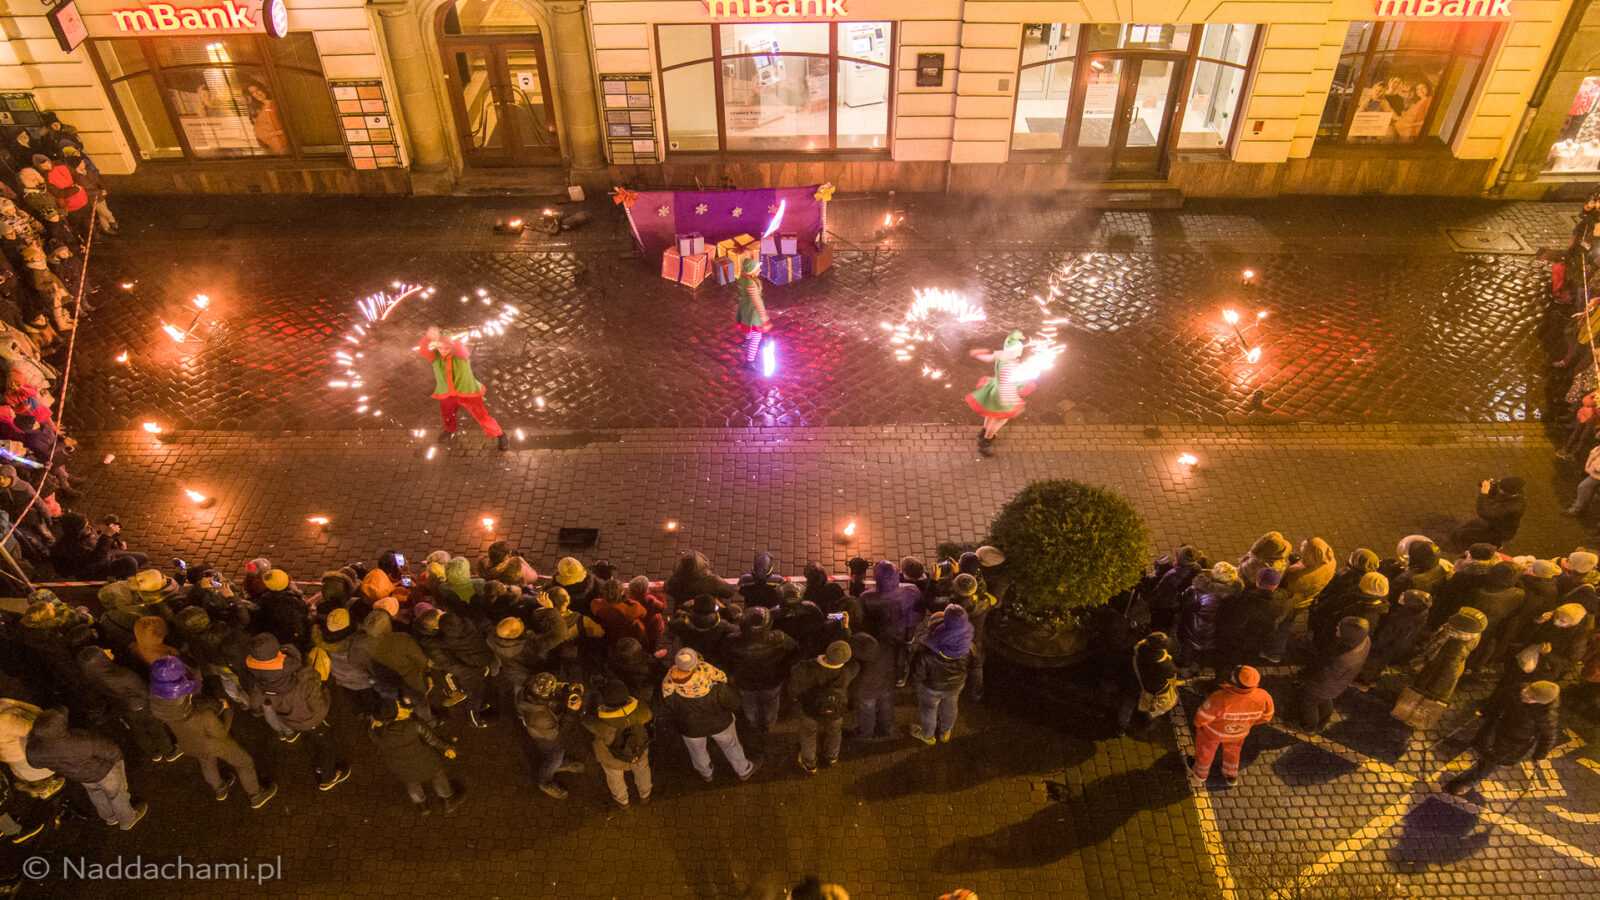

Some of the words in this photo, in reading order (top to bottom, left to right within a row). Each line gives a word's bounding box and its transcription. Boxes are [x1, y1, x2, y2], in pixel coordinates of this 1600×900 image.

[112, 1, 255, 31] mBank
[708, 0, 848, 17] mBank
[1377, 0, 1511, 17] mBank
